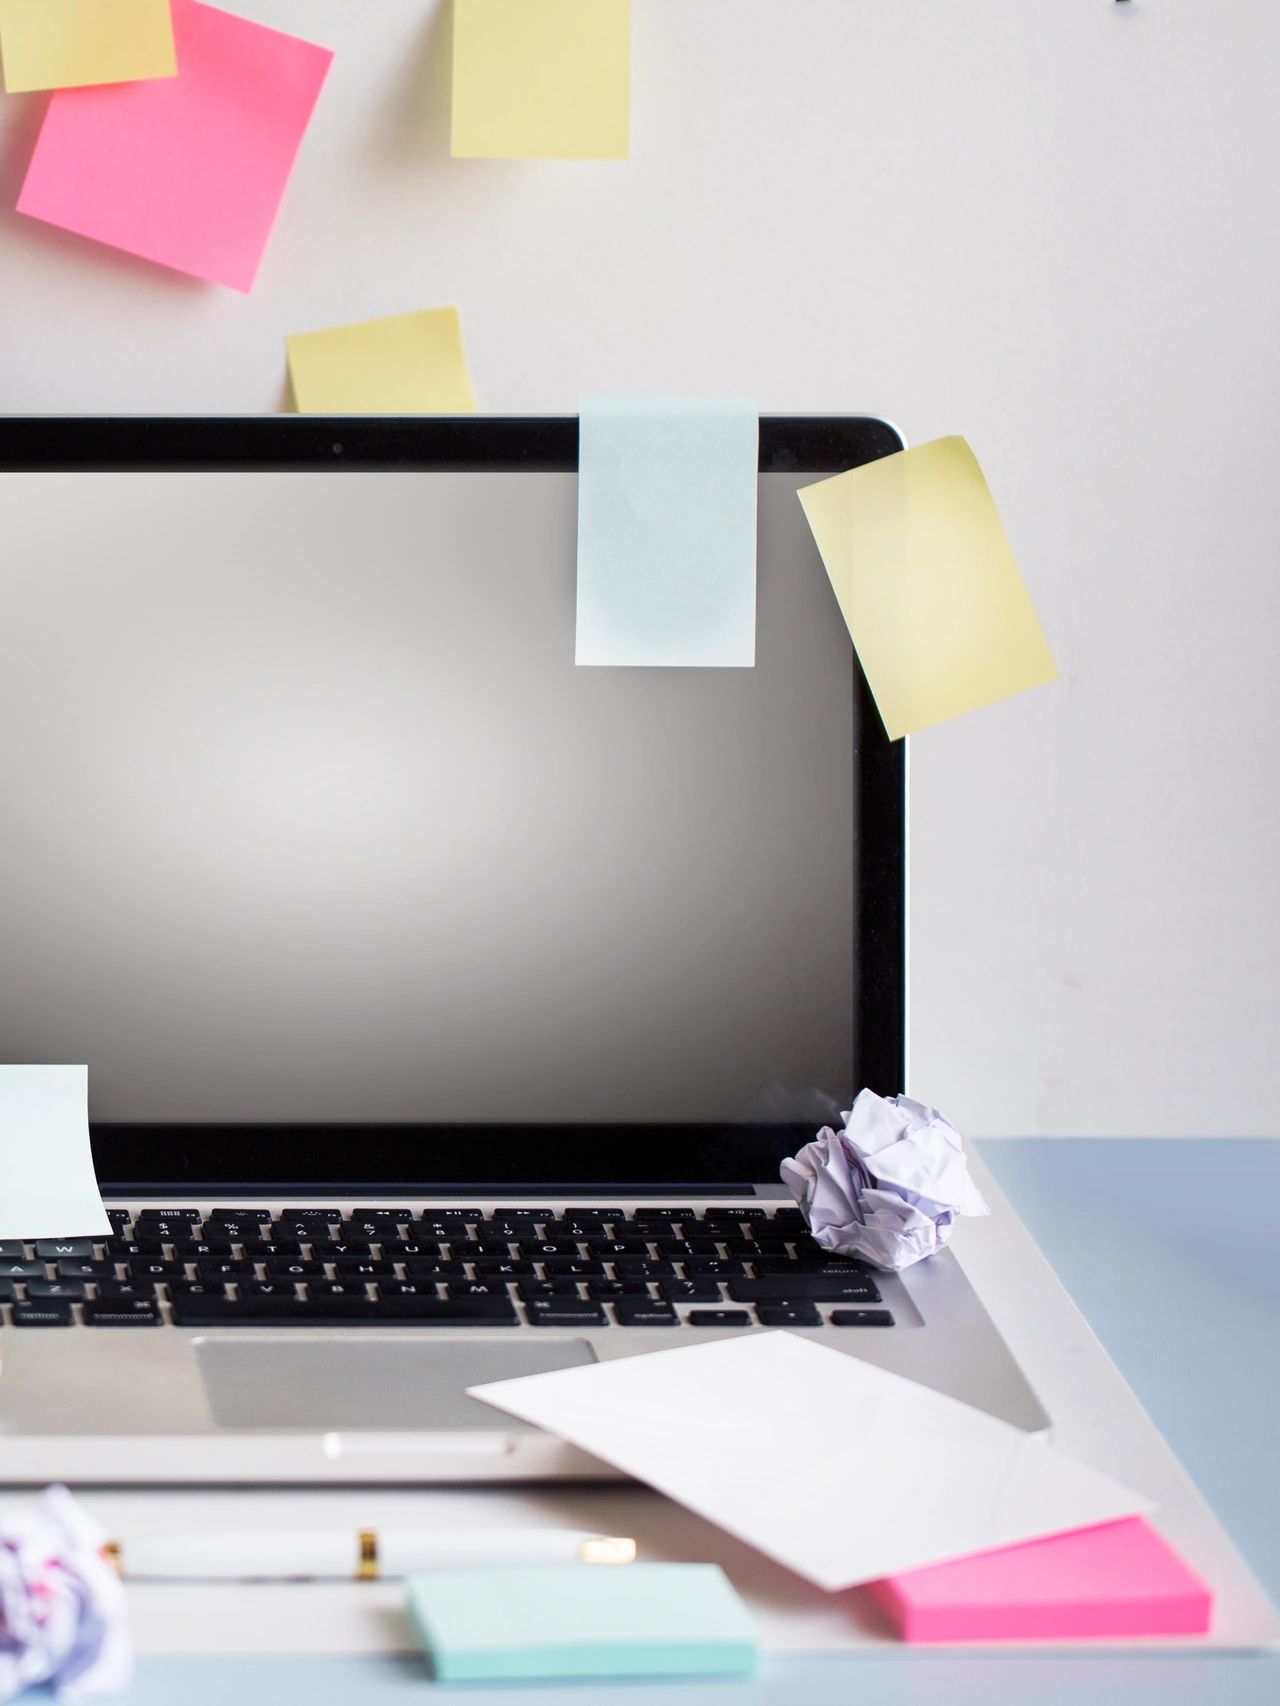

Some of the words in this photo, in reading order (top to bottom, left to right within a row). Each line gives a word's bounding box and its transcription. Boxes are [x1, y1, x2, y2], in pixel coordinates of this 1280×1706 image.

[335, 1245, 348, 1253] Y
[81, 1265, 94, 1273] S
[48, 1285, 62, 1293] Z
[260, 1285, 273, 1293] V
[400, 1285, 417, 1293] N
[470, 1285, 489, 1293] M
